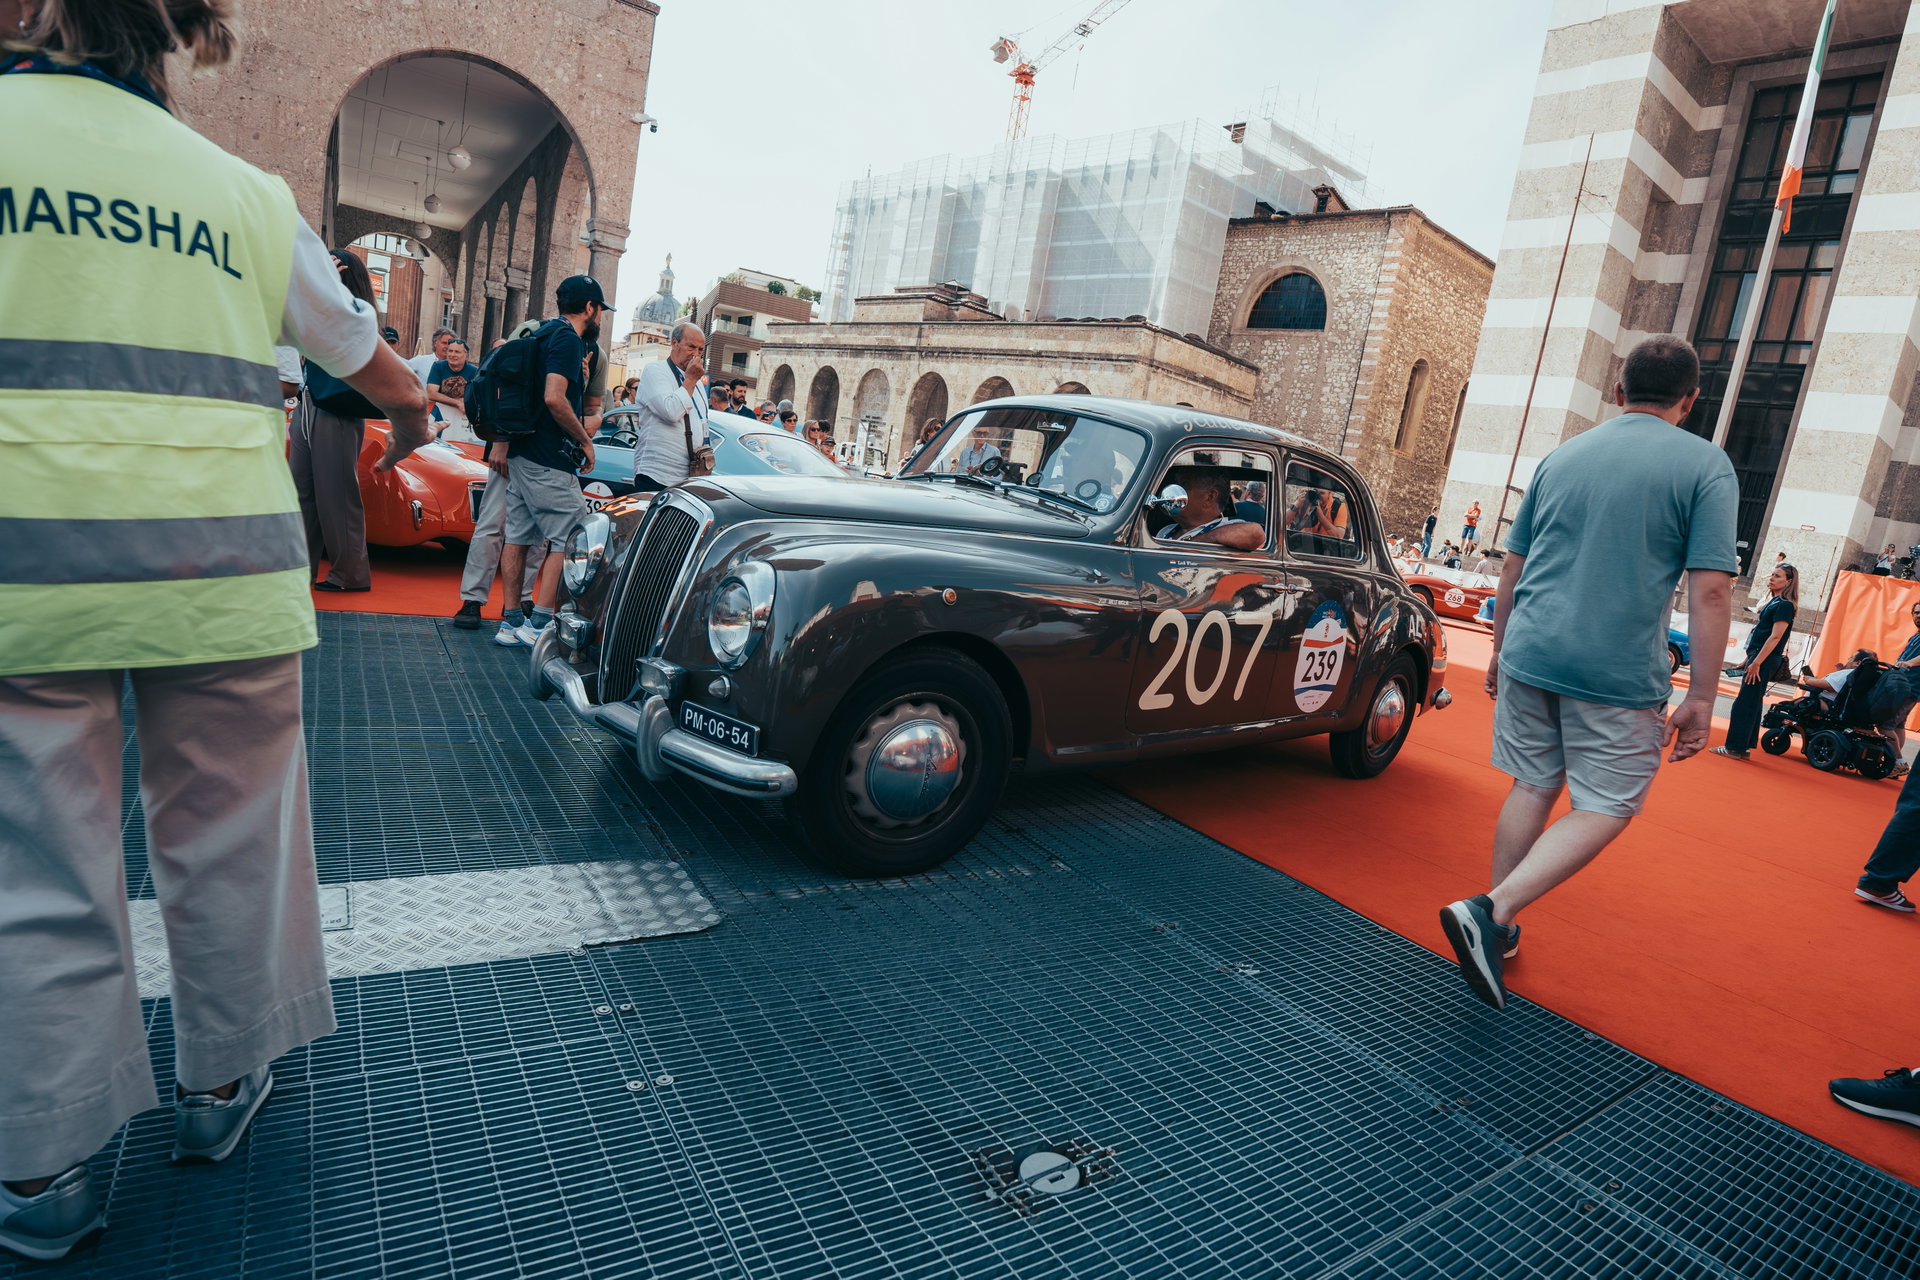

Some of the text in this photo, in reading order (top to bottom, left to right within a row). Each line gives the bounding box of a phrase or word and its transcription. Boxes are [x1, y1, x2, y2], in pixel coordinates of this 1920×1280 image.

[1447, 593, 1462, 603] 268
[1138, 608, 1273, 710] 207
[1301, 650, 1338, 682] 239
[685, 708, 749, 749] PM-06-54
